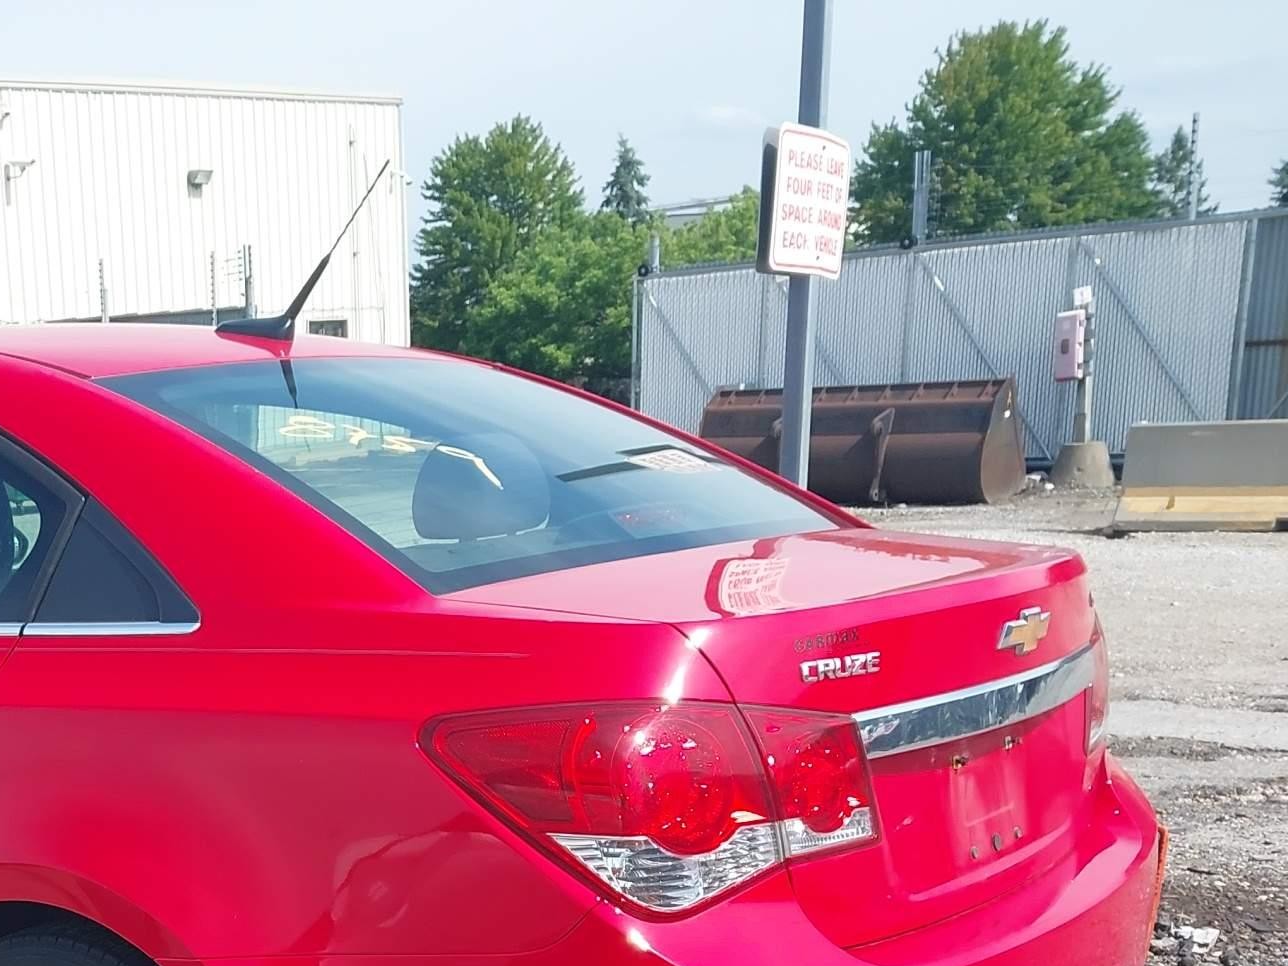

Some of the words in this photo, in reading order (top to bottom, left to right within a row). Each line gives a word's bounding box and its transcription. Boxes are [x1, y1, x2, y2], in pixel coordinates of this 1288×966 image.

[788, 149, 823, 172] PLEASE
[826, 158, 844, 179] LEAVE
[786, 177, 813, 196] FOUR
[817, 181, 834, 201] FEET
[835, 187, 843, 204] OF
[781, 203, 813, 223] SPACE
[817, 207, 842, 231] AROUND
[782, 231, 809, 250] EACH
[814, 235, 838, 256] VEHICLE
[799, 651, 881, 683] CRUZE
